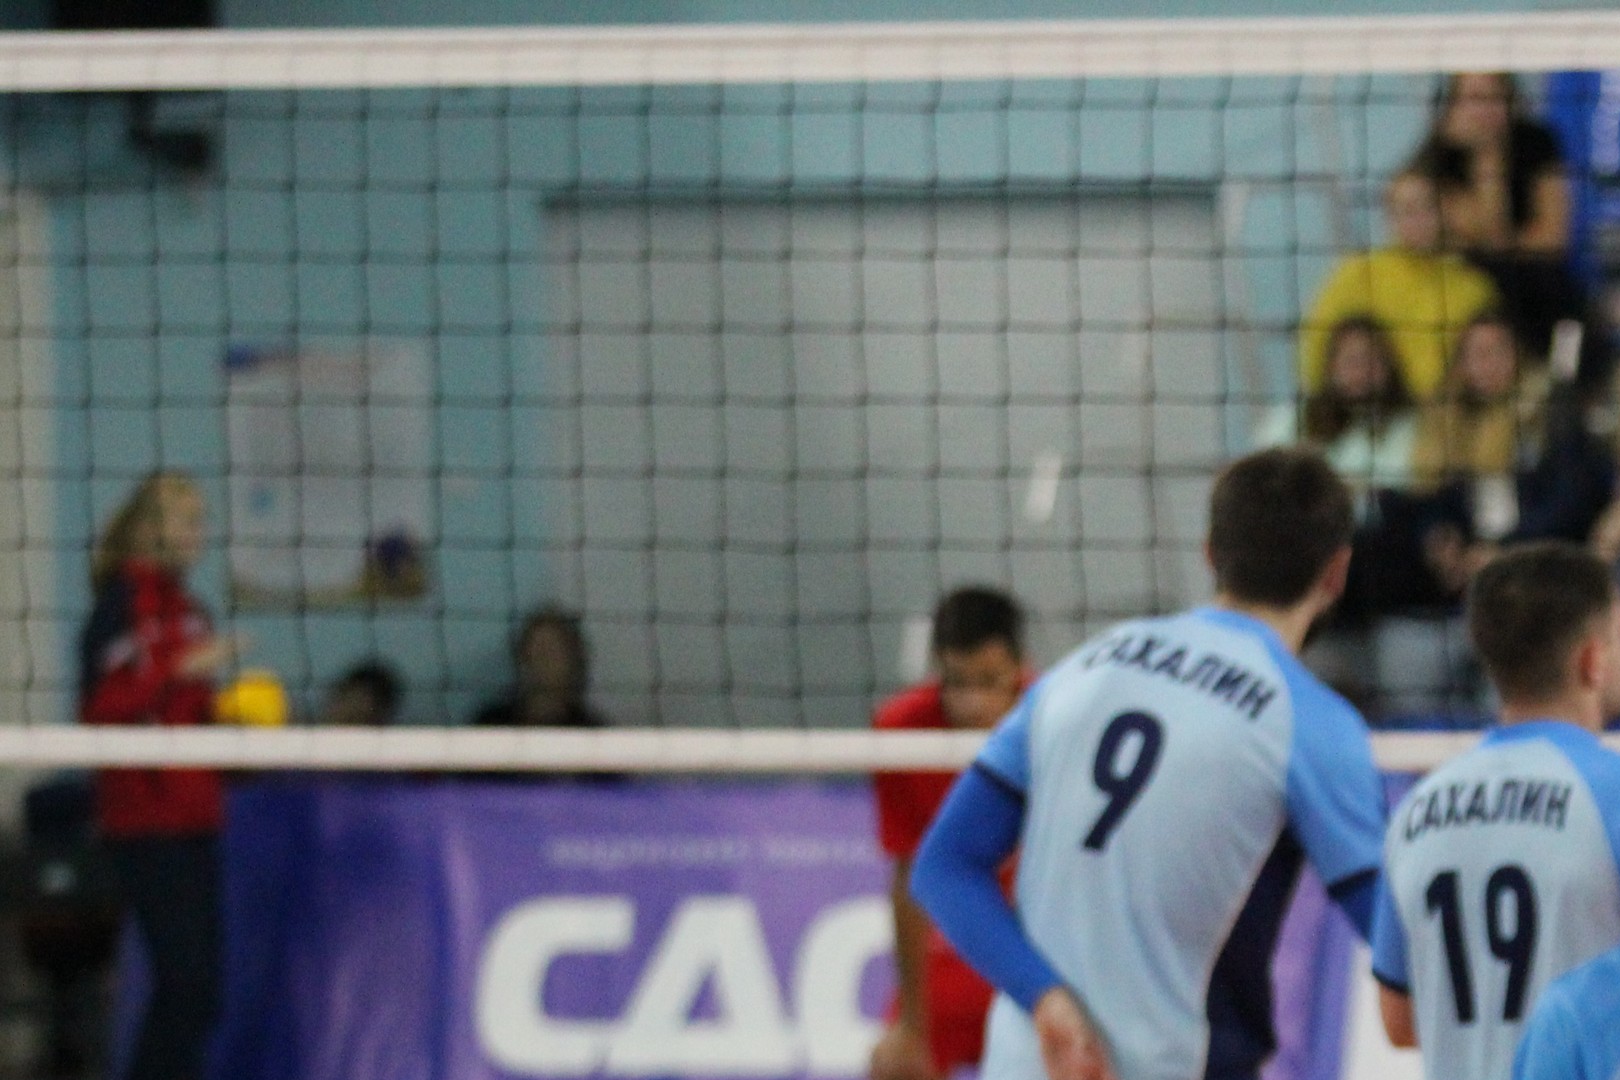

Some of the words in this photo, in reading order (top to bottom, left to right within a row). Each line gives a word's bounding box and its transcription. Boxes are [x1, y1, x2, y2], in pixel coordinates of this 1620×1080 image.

[1083, 709, 1167, 852] 9
[1405, 776, 1574, 842] САХАЛИН
[1424, 864, 1541, 1026] 19
